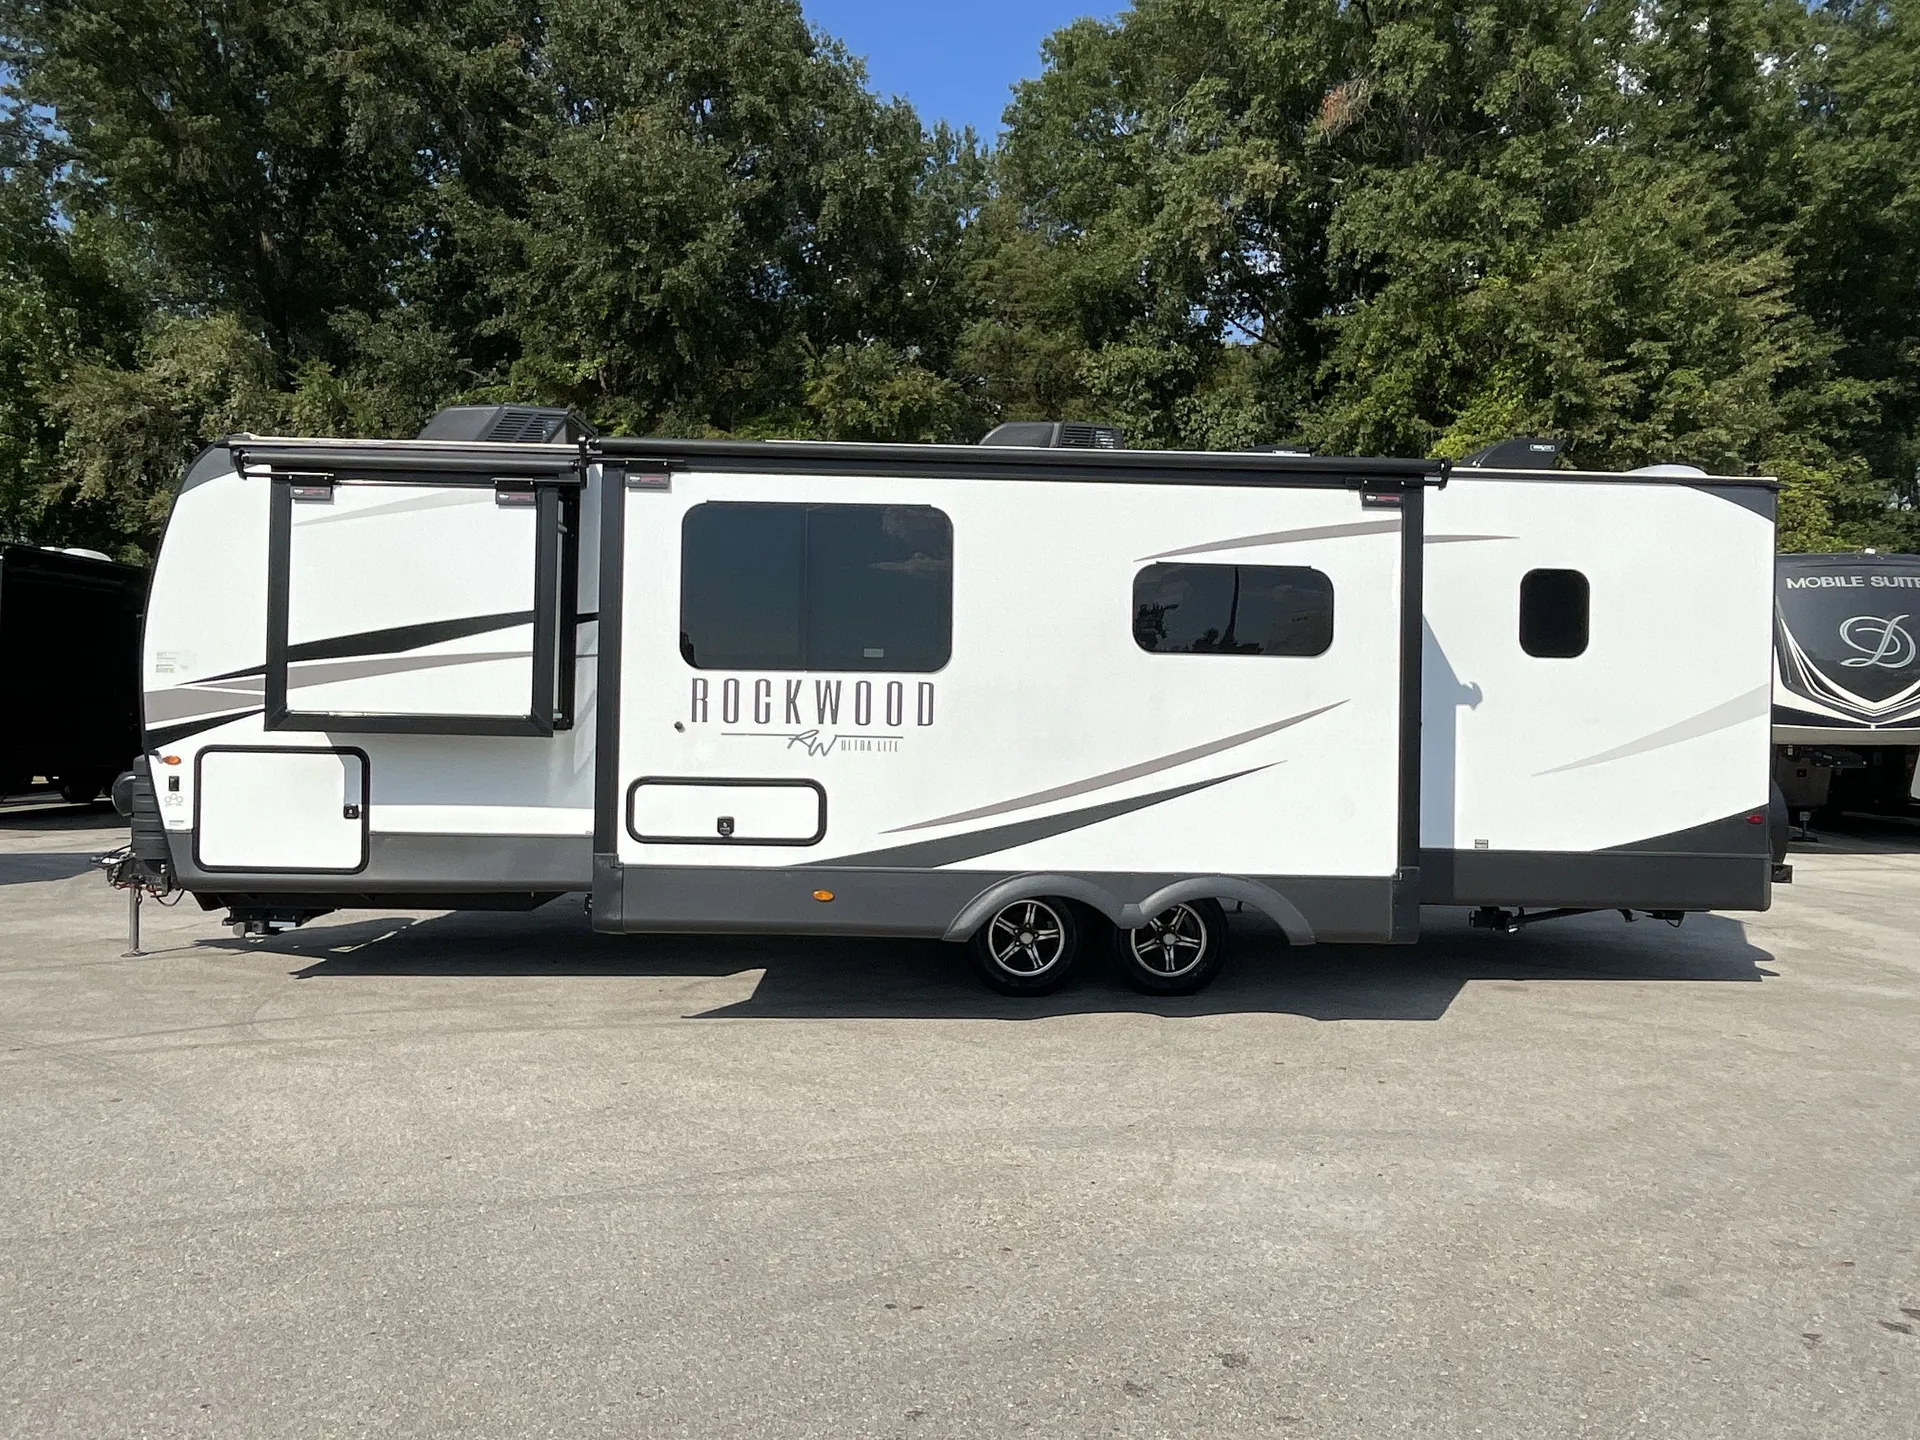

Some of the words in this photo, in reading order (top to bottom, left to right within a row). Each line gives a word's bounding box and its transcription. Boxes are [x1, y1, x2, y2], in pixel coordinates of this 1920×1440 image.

[1785, 576, 1865, 589] MOBILE
[691, 677, 935, 727] ROCKWOOD
[841, 739, 872, 752] ULTRA
[877, 740, 900, 753] LITE
